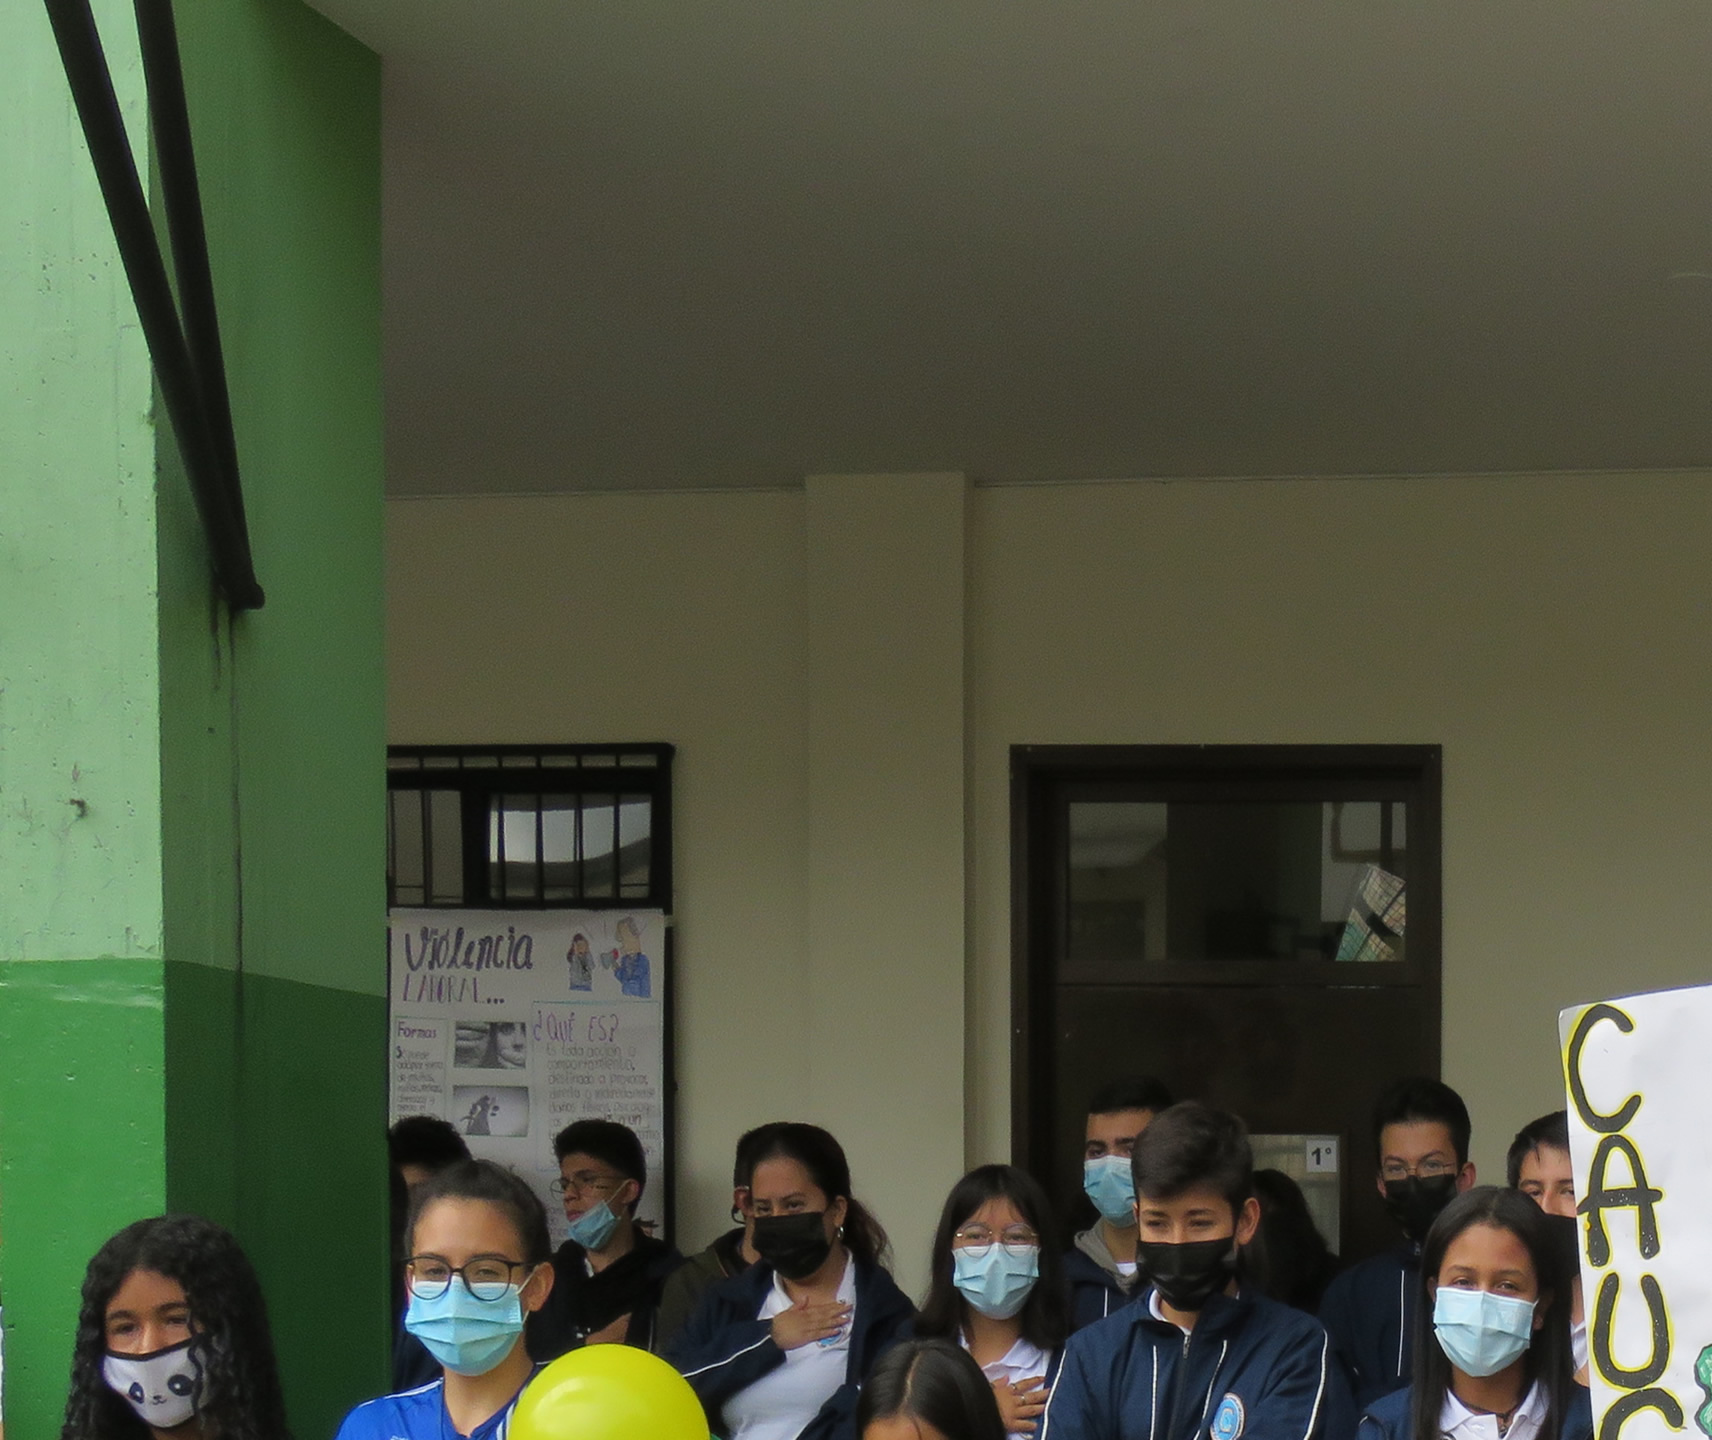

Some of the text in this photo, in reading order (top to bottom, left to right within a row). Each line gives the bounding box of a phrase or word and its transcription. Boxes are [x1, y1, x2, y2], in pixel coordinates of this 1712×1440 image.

[404, 925, 534, 971] Violencia
[397, 1020, 437, 1040] Formas
[588, 1013, 620, 1043] ES?
